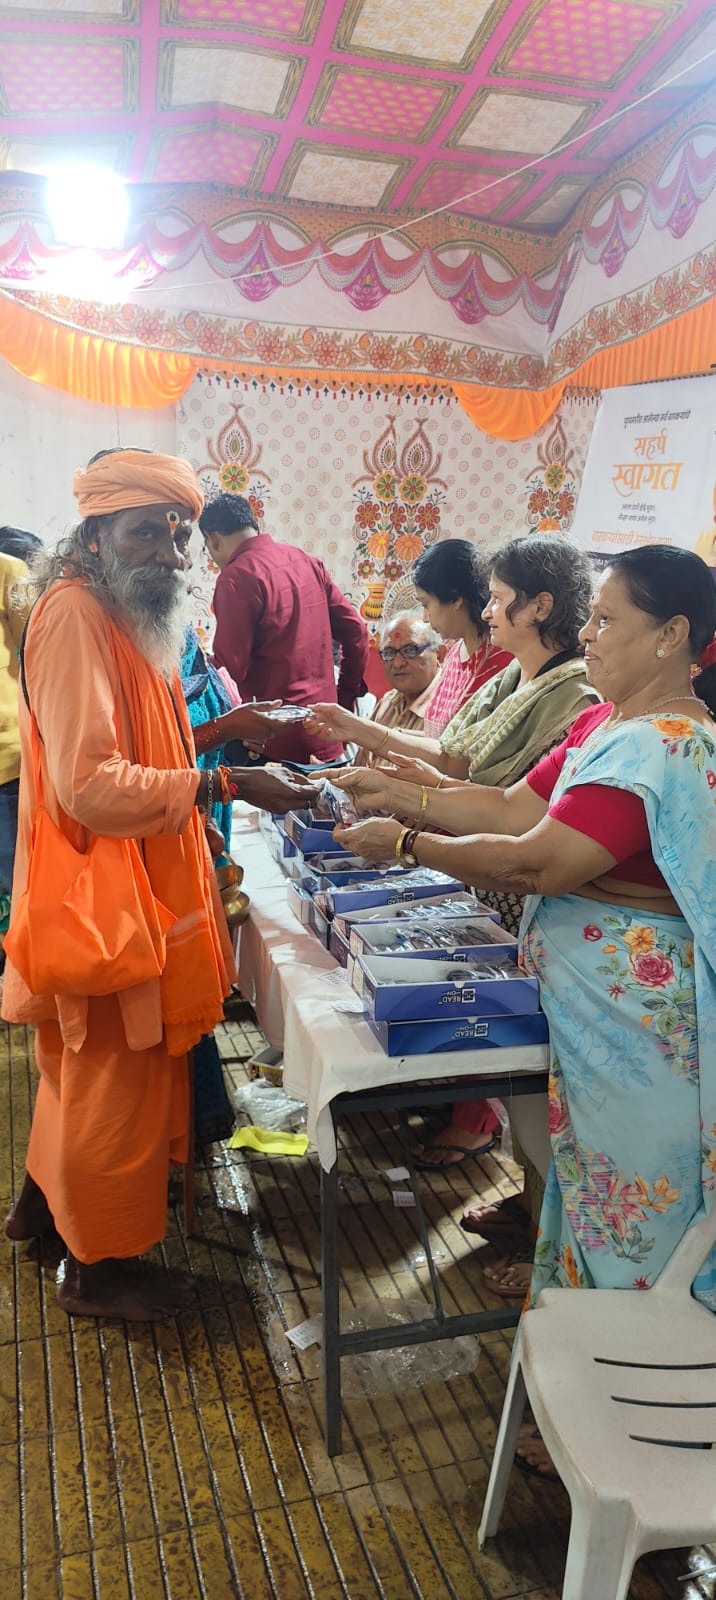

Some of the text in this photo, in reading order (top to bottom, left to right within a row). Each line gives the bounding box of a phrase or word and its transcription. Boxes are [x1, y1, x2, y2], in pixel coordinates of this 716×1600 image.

[634, 428, 668, 460] सहर्ष
[612, 463, 684, 497] स्वागत
[455, 1030, 473, 1038] READ
